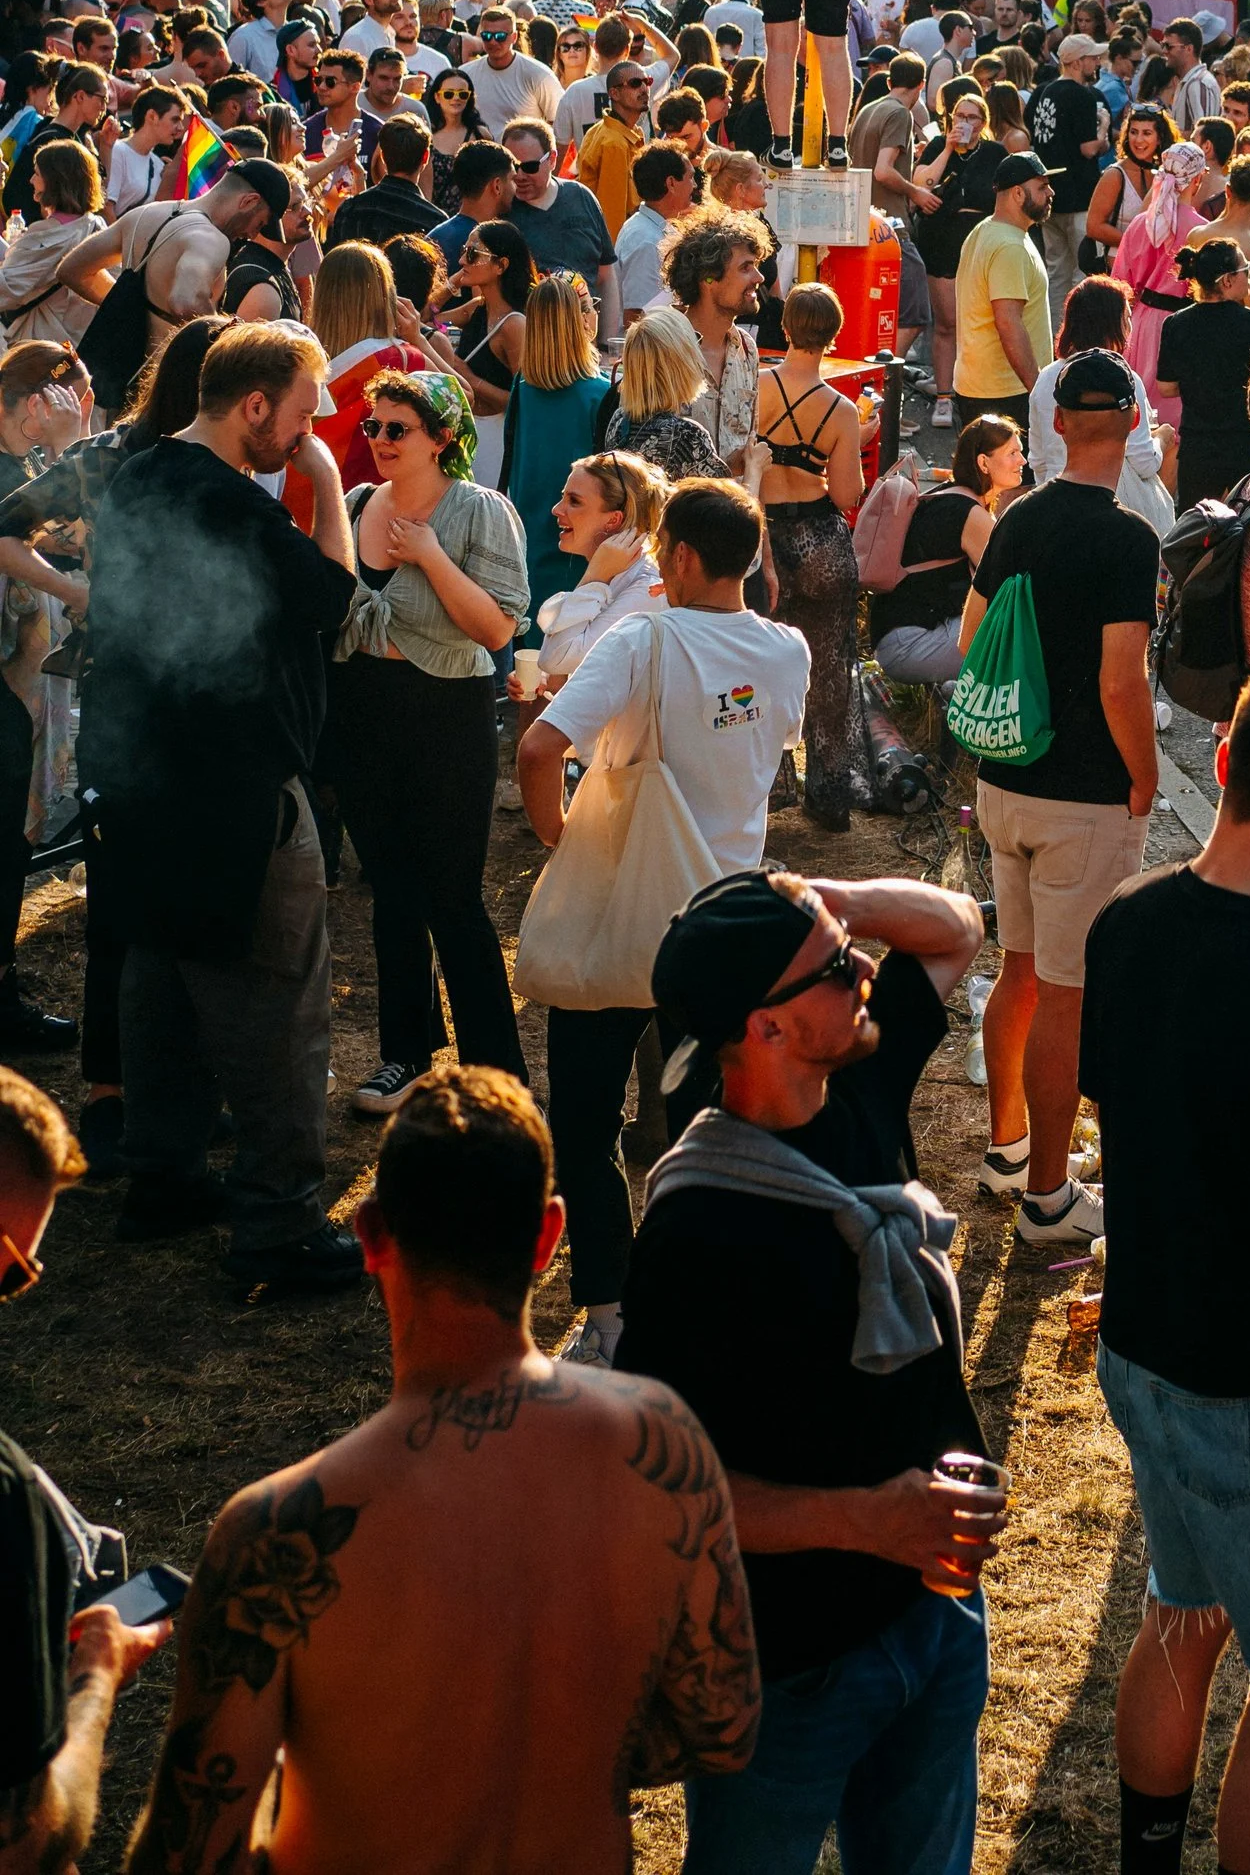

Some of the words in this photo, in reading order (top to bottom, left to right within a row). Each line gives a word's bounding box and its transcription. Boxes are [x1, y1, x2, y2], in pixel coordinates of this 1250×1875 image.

[880, 315, 893, 331] BSR
[718, 692, 730, 713] I
[713, 705, 764, 730] ISRAEL
[947, 706, 1022, 749] GETRAGEN
